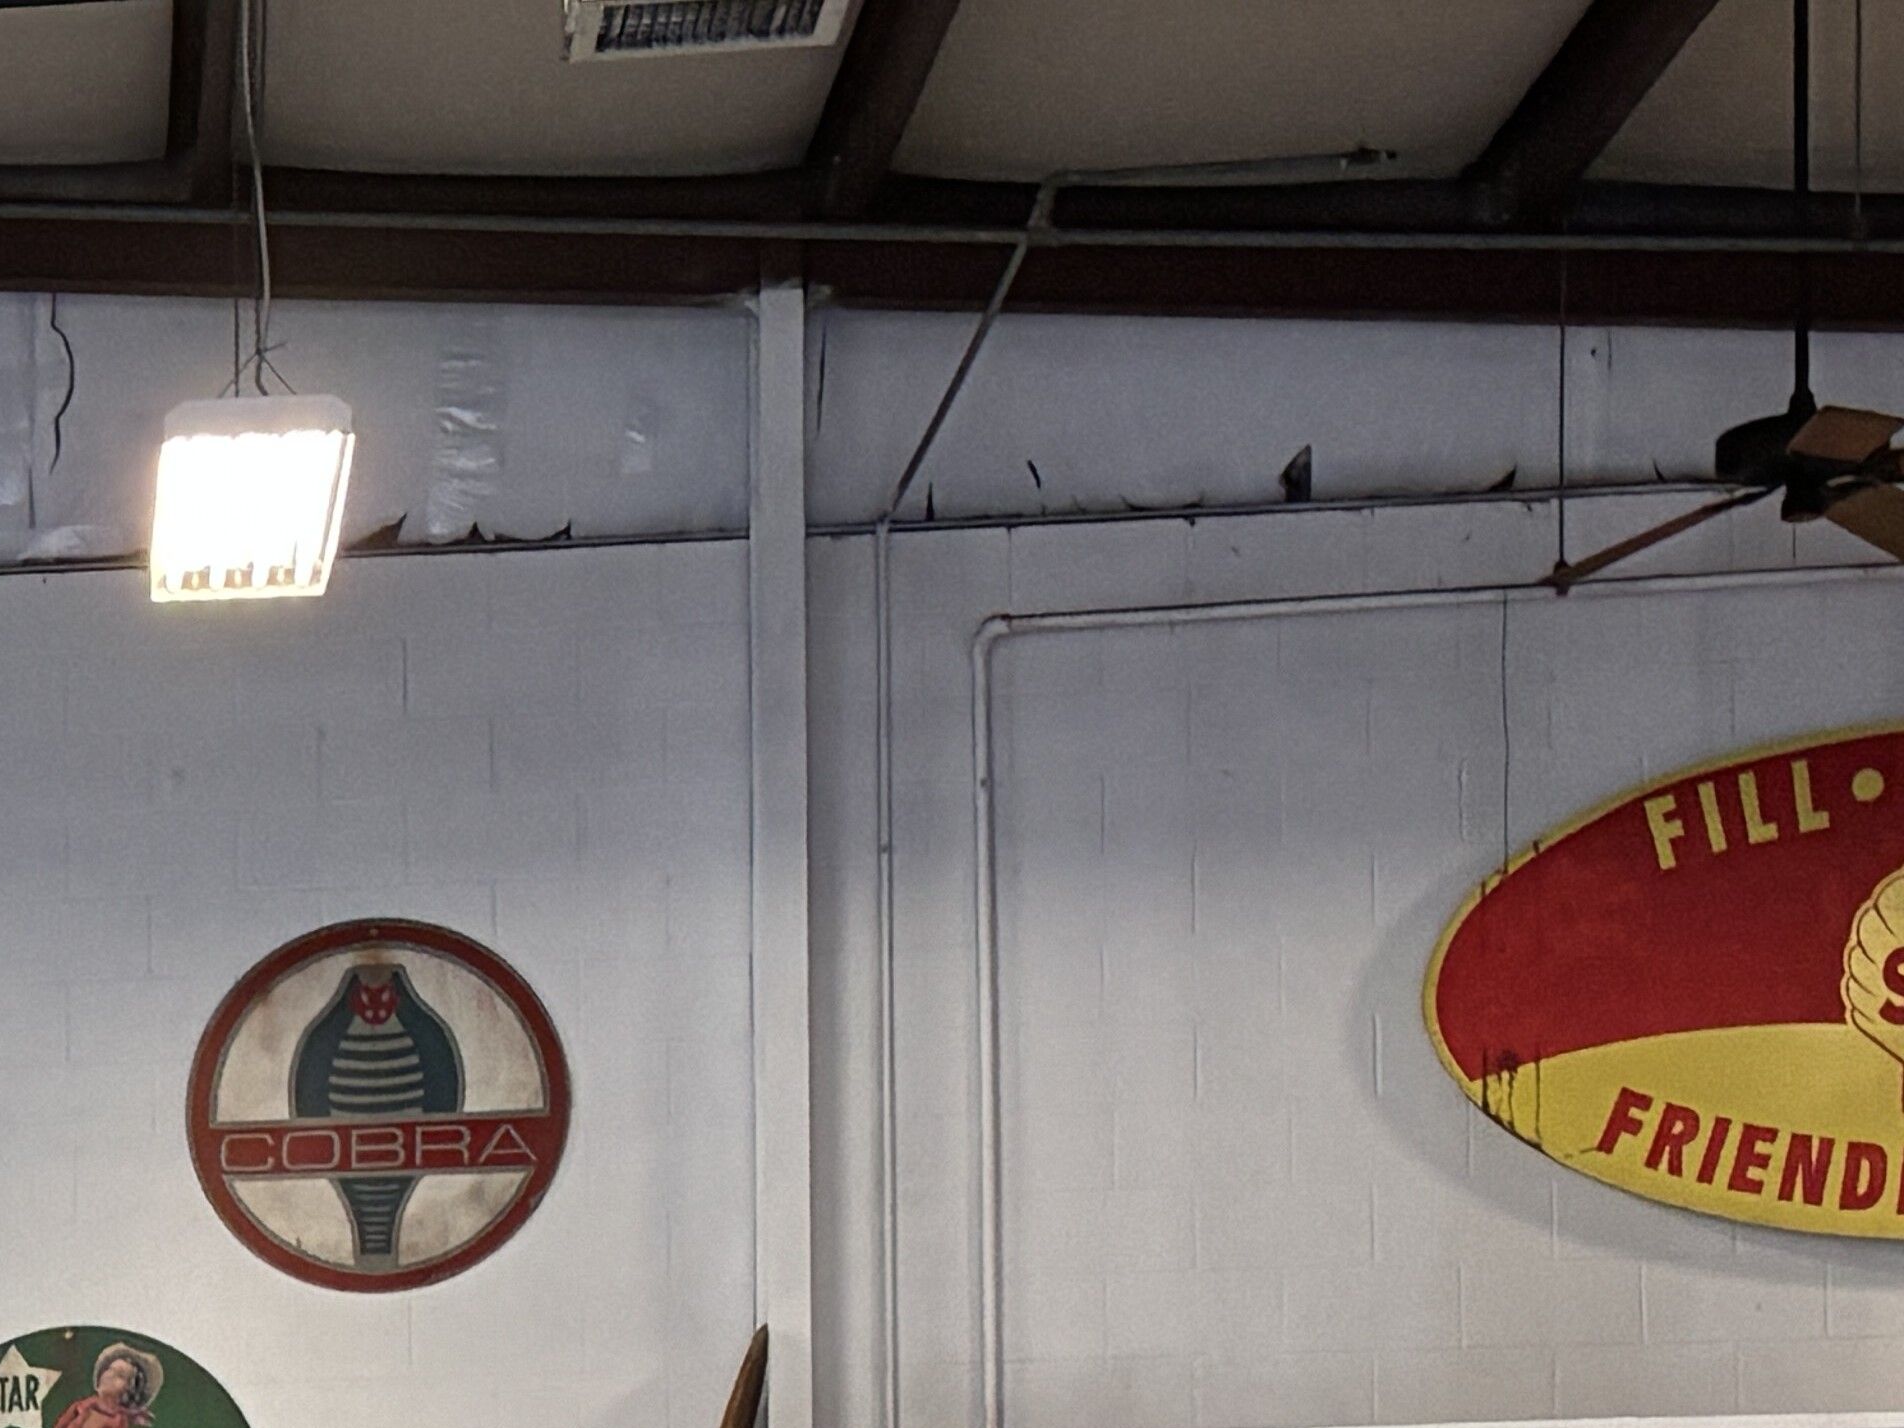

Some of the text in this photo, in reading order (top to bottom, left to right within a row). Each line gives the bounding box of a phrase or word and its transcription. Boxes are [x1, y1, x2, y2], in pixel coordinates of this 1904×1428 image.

[1643, 759, 1830, 871] FILL
[219, 1123, 537, 1172] COBRA
[1595, 1086, 1904, 1216] FRIEND
